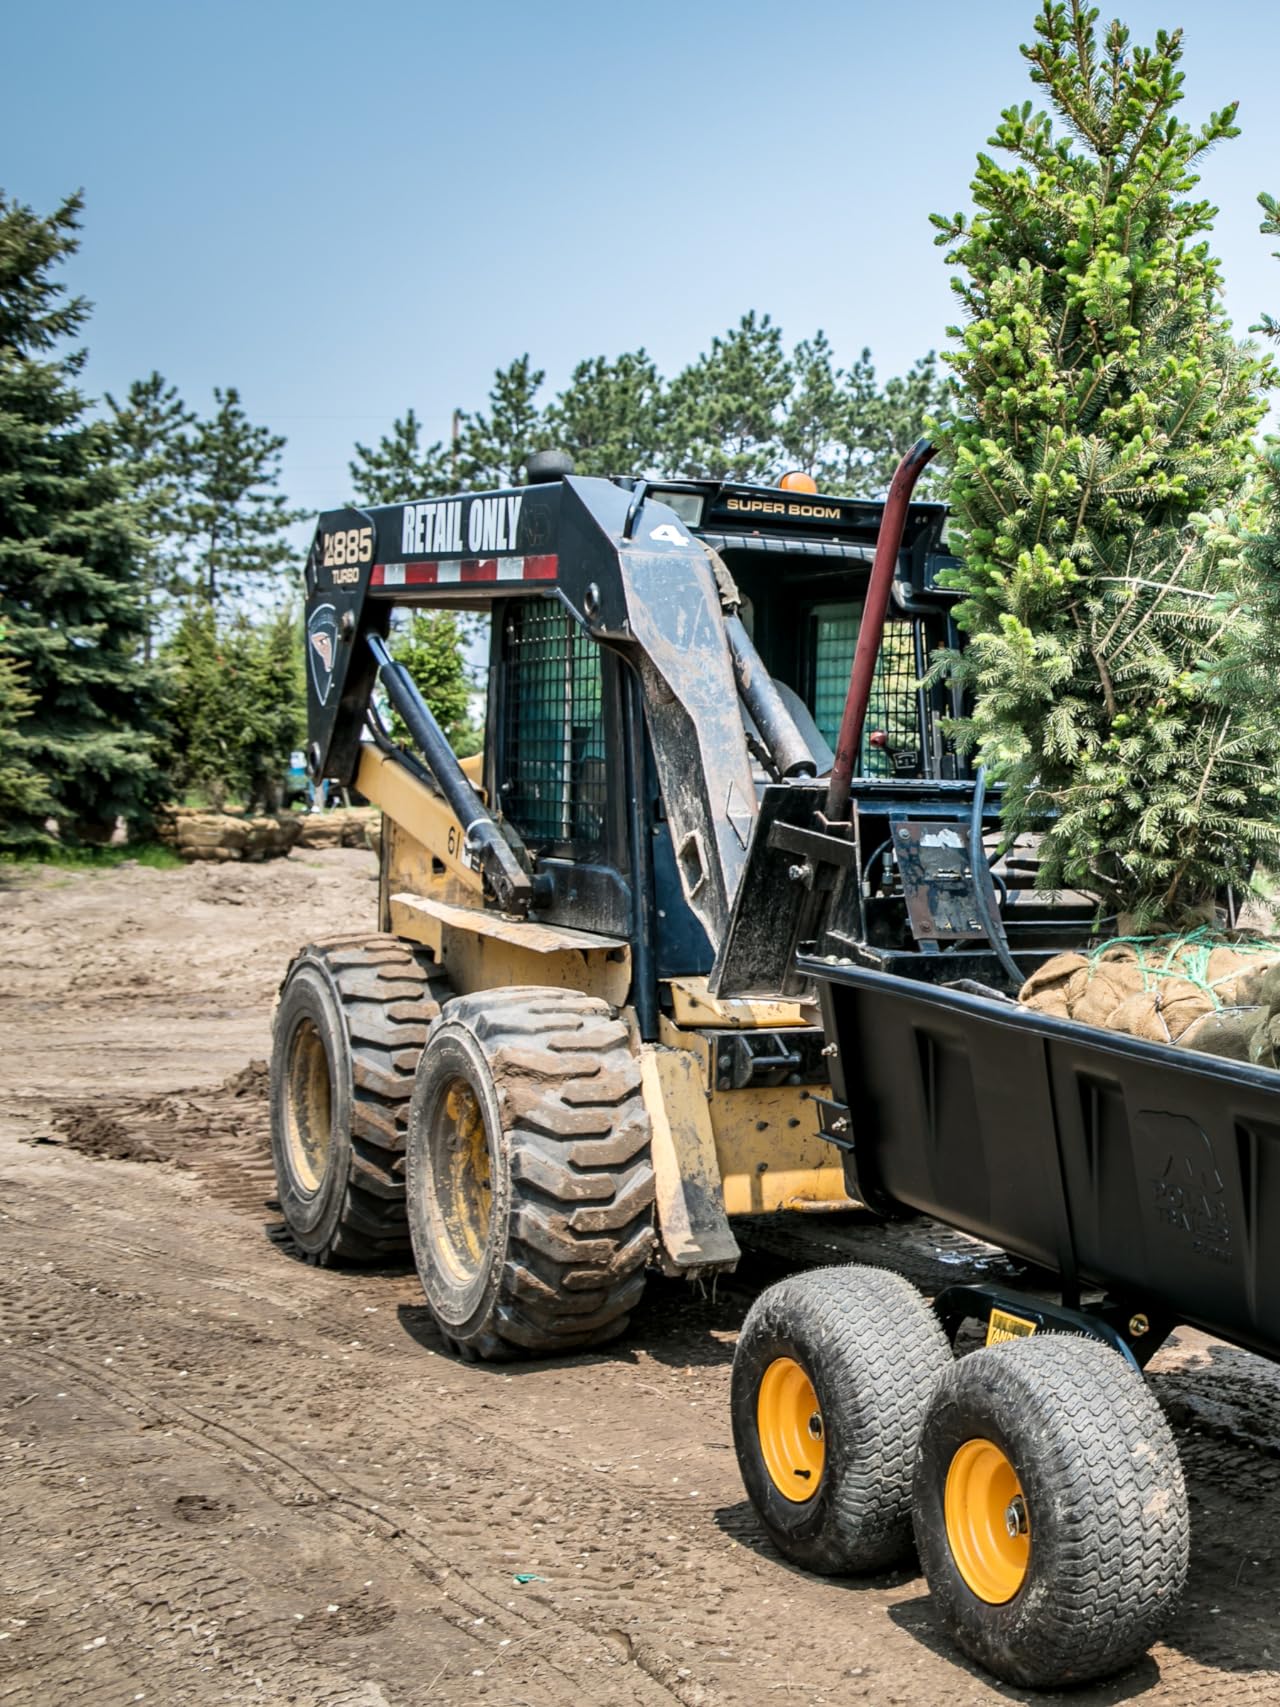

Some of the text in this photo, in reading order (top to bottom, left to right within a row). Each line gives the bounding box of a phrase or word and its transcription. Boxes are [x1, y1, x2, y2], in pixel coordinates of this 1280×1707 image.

[727, 499, 841, 519] SUPER BOOM
[402, 502, 462, 554] RETAIL
[469, 496, 522, 552] ONLY
[650, 524, 689, 547] 4
[332, 567, 360, 585] TURBO
